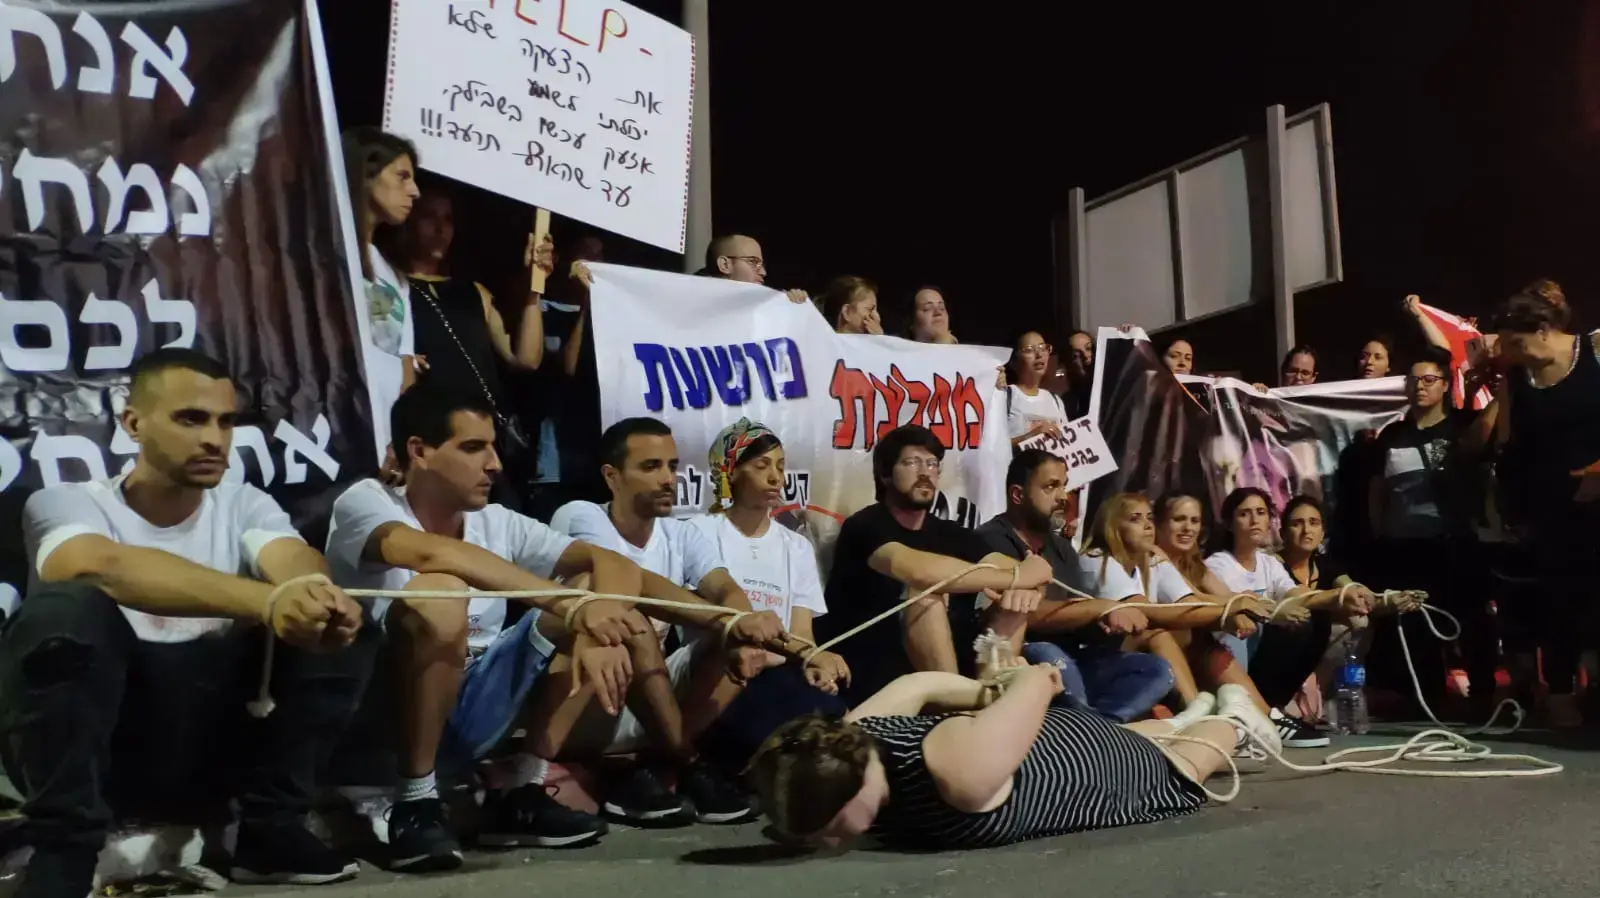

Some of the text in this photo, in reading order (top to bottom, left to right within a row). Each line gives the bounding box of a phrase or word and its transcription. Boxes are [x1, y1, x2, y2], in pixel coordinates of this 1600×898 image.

[449, 4, 663, 115] את הצעקה שלא
[600, 180, 632, 207] עד
[0, 278, 197, 371] לכם
[829, 359, 985, 451] מפלצת
